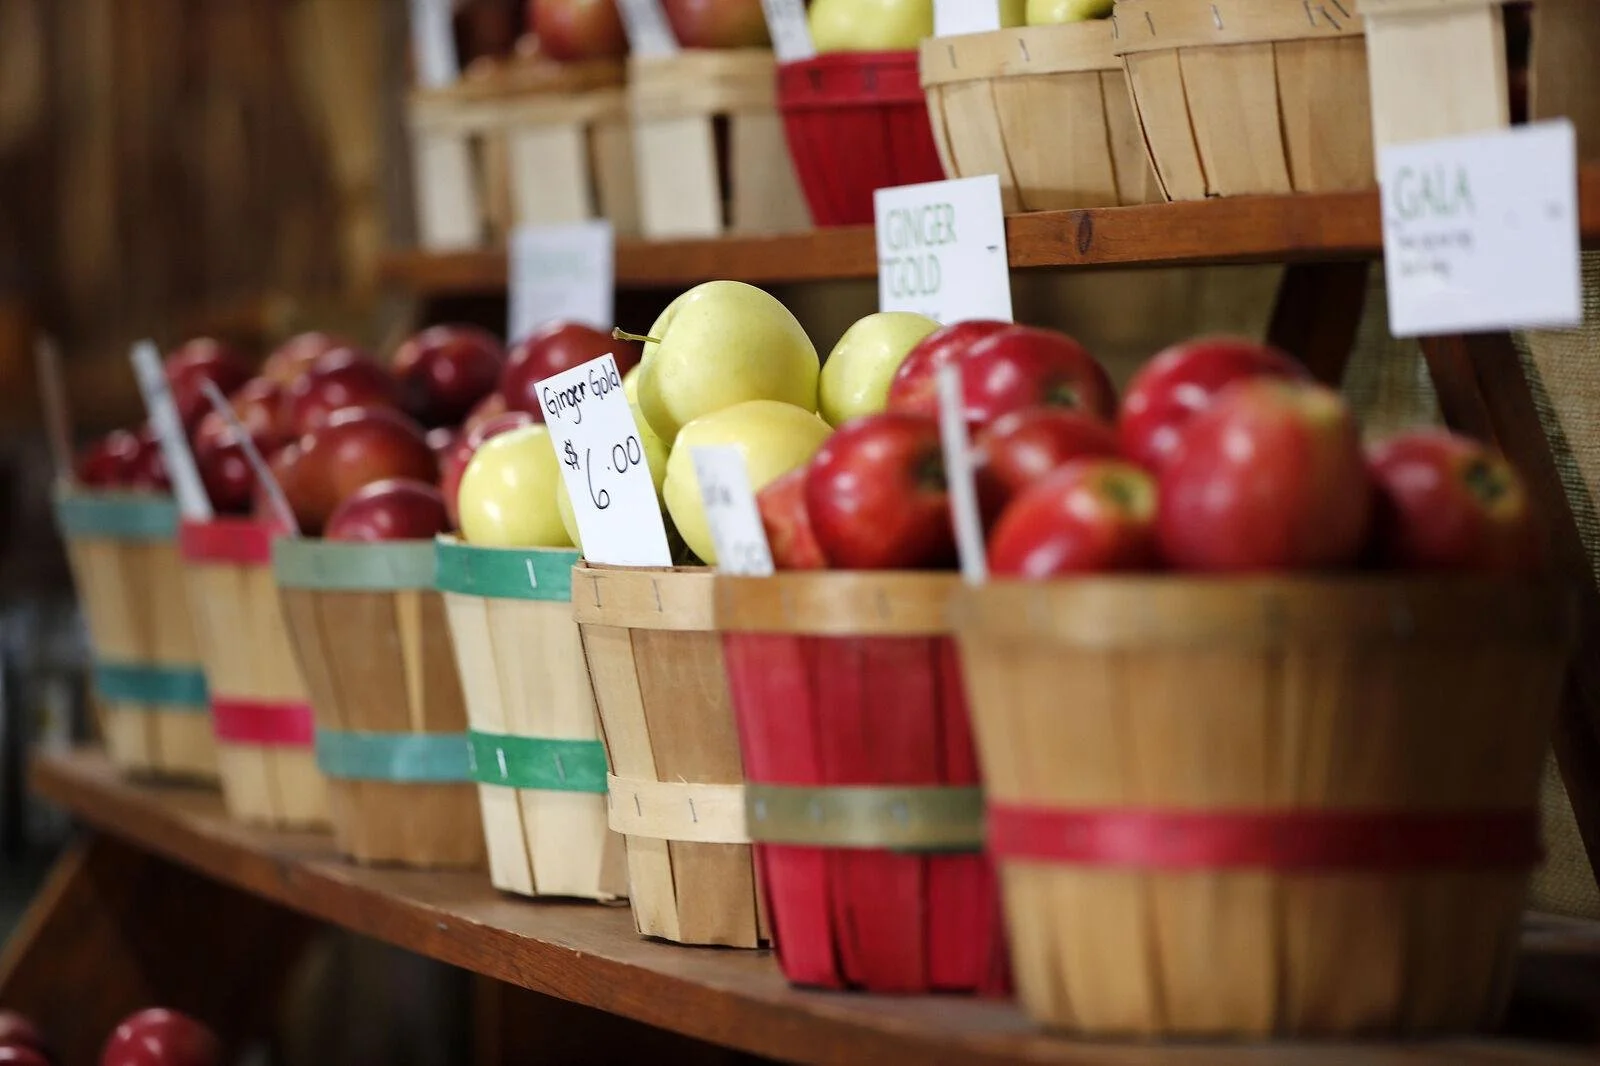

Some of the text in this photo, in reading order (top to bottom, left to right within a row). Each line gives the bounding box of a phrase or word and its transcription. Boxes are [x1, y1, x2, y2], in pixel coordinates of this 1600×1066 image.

[1393, 161, 1476, 220] GALA
[886, 203, 957, 250] GINGER
[887, 254, 942, 298] GOLD
[543, 358, 620, 425] Ginger Gold
[563, 435, 642, 510] $6.00
